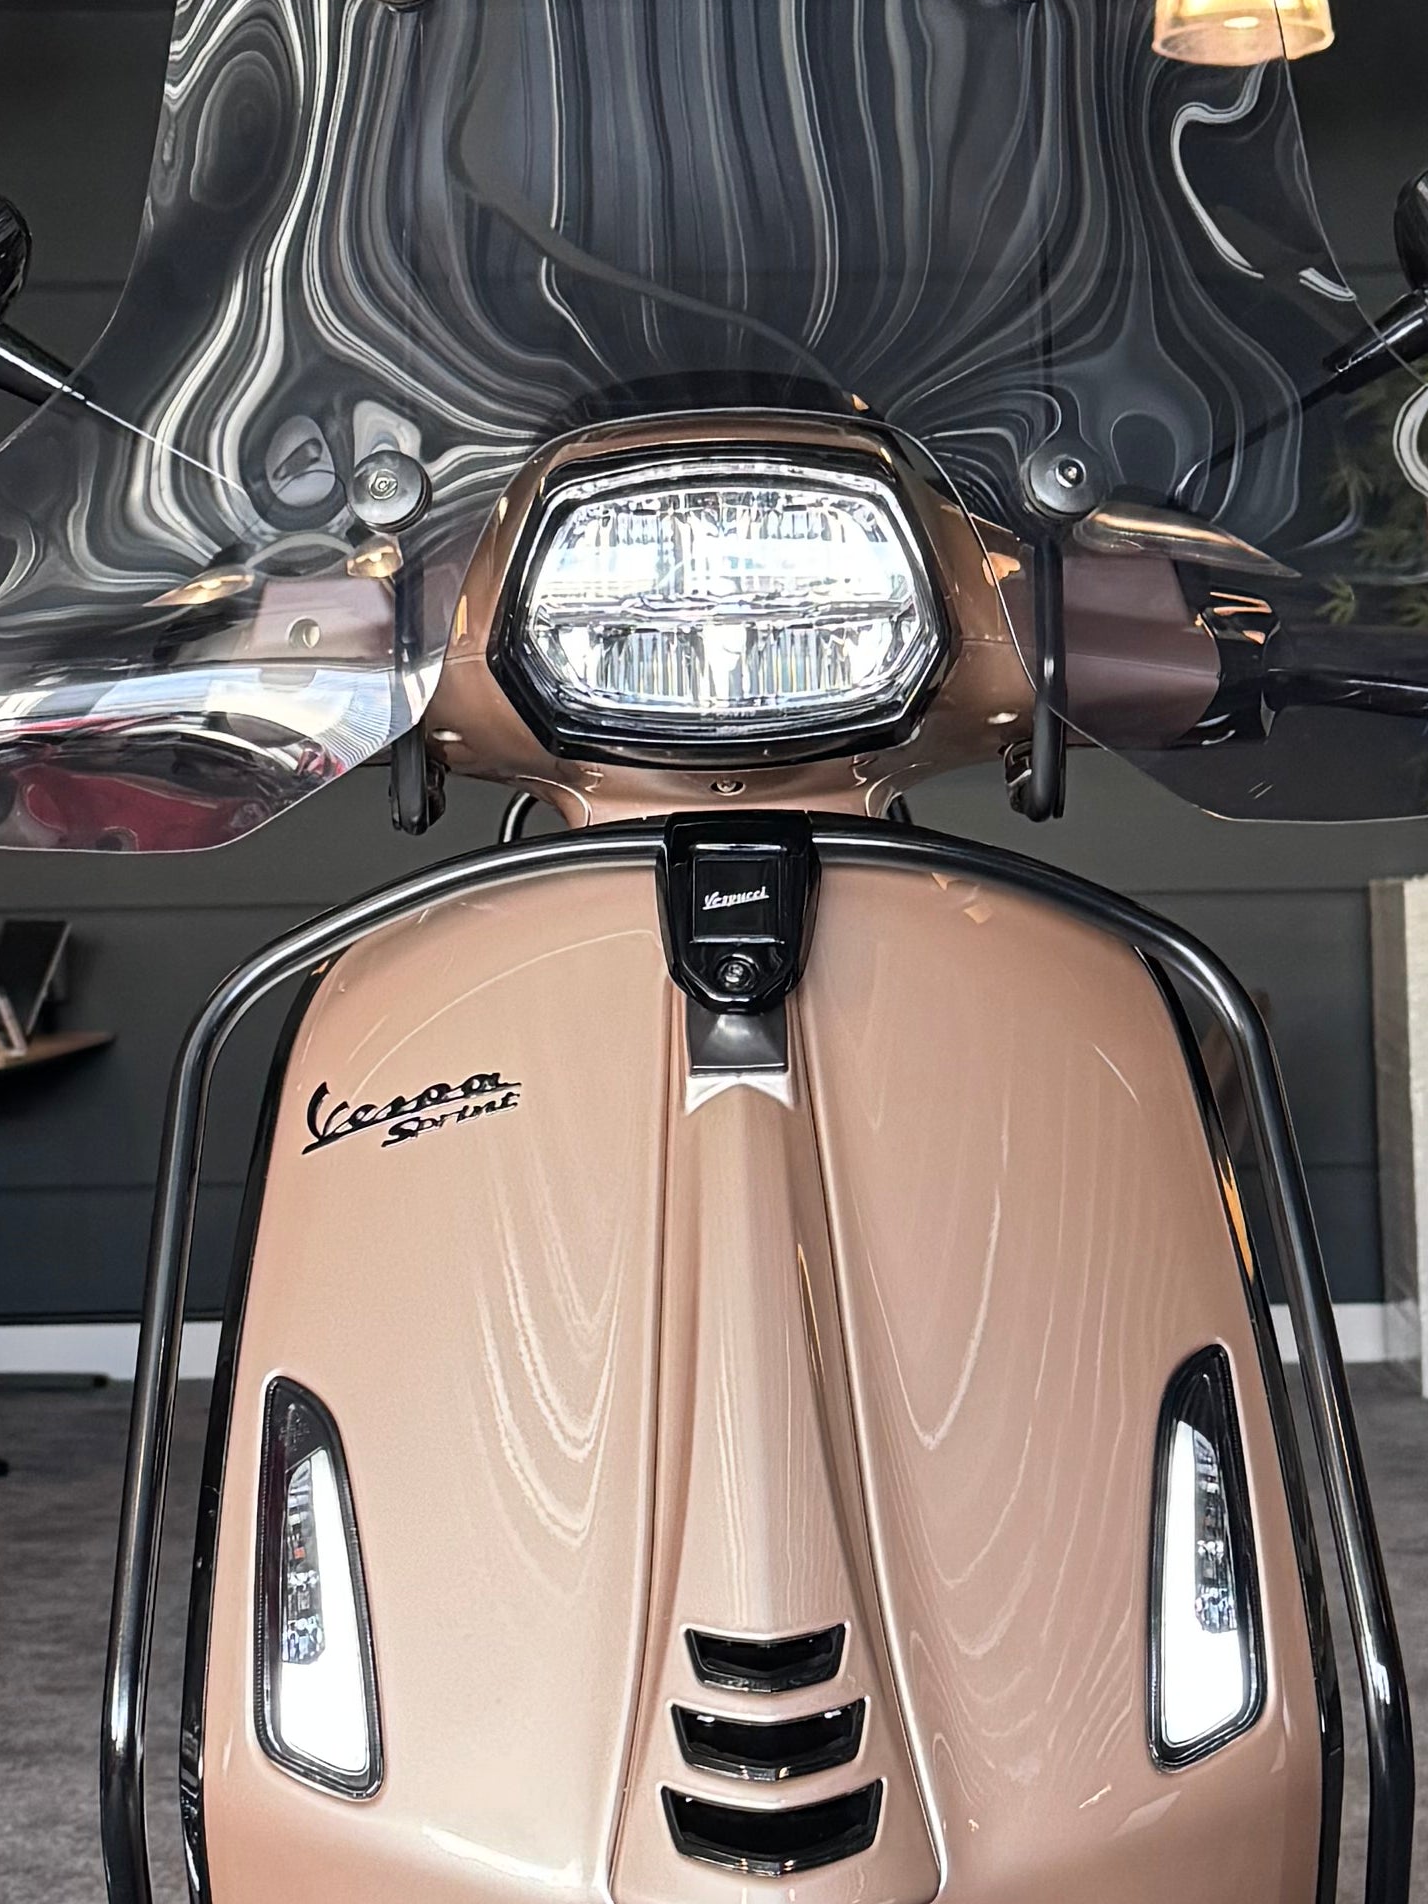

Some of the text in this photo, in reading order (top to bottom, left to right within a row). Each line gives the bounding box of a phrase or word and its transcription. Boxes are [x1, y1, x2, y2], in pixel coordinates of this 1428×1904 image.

[702, 886, 769, 911] Vespucci
[301, 1071, 523, 1156] Vespa
[381, 1091, 521, 1148] Sprint
